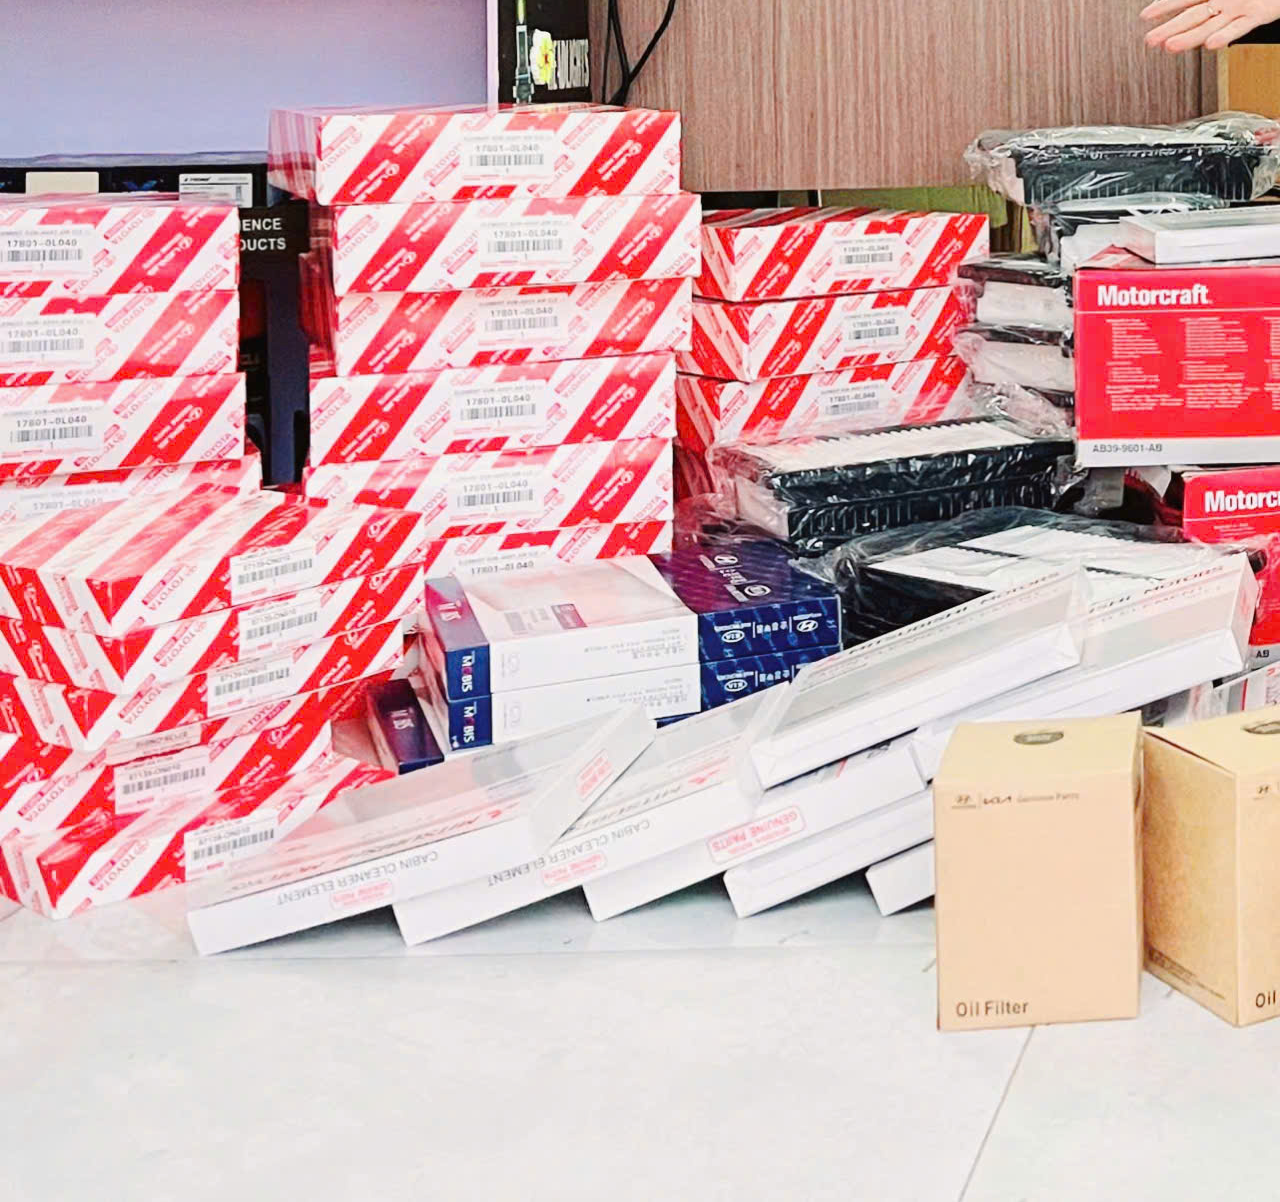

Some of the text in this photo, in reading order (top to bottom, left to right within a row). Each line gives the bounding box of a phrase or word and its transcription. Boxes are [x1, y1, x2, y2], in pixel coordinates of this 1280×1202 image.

[1097, 284, 1209, 306] Motorcraft
[466, 393, 531, 406] 17801-0L040
[16, 415, 88, 429] 17801-0L040
[1092, 443, 1163, 453] AB39-9601-AB
[611, 818, 651, 839] CABIN
[750, 811, 798, 840] GENUINE
[549, 832, 608, 862] CLEANER
[711, 832, 747, 854] PARTS
[399, 850, 439, 869] CABIN
[335, 864, 397, 888] CLEANER
[486, 857, 547, 887] ELEMENT
[276, 880, 333, 906] ELEMENT
[955, 999, 1029, 1018] Oil Filter
[1254, 992, 1277, 1009] Oil
